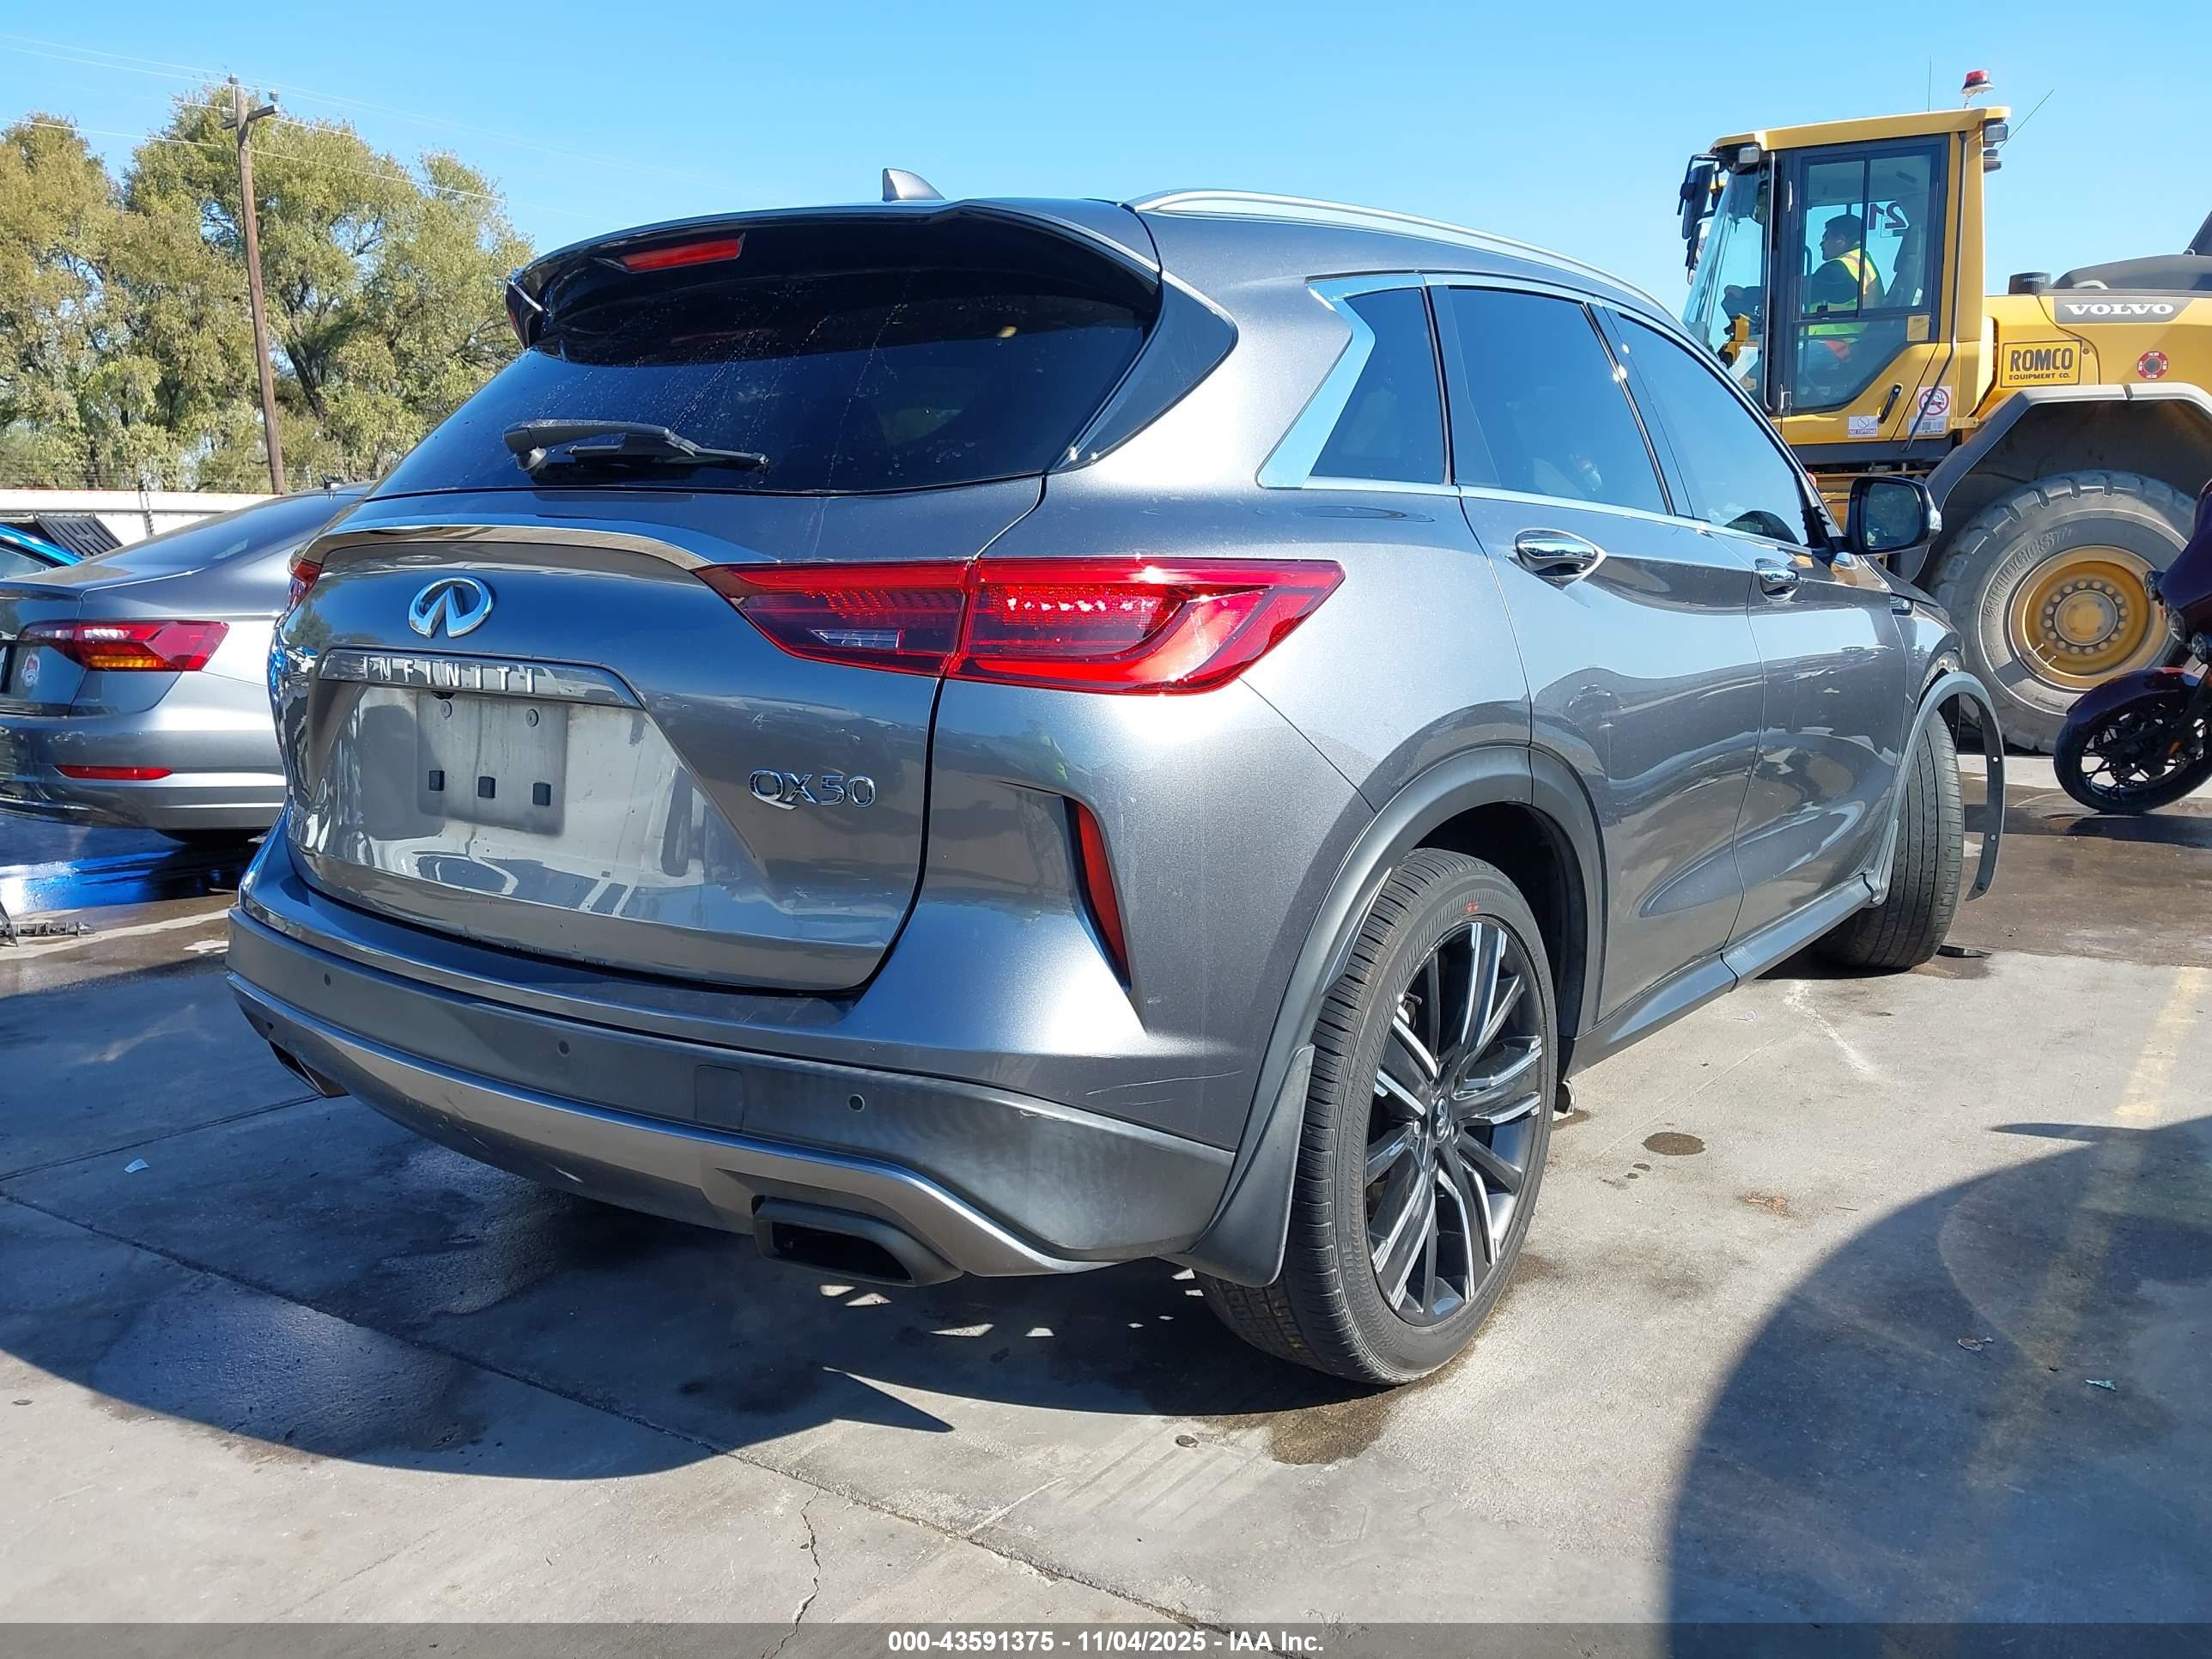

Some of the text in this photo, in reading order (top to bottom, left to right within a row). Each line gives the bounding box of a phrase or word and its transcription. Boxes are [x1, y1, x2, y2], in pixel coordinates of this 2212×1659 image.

[2065, 303, 2173, 315] VOLVO
[2010, 348, 2073, 371] ROMCO
[361, 656, 535, 694] INFINITI
[749, 769, 876, 811] QX50
